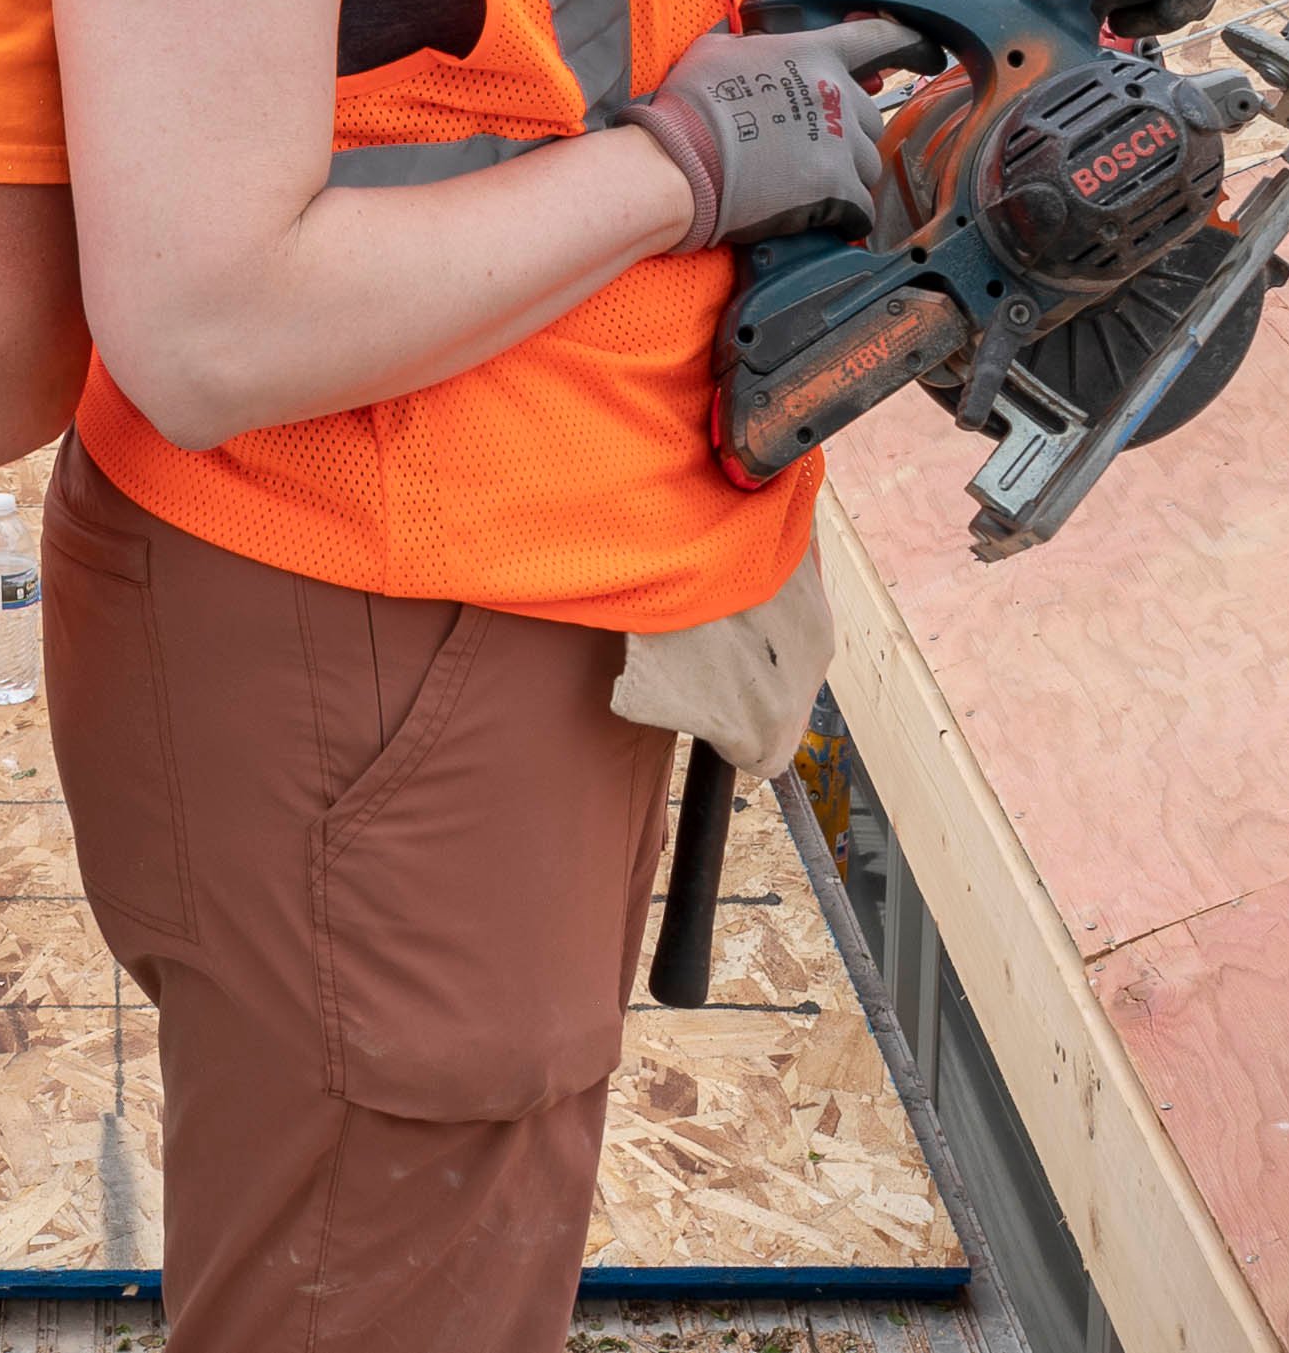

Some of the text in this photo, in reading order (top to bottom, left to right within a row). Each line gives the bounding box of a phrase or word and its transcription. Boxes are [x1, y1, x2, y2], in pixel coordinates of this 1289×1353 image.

[772, 113, 786, 124] 8
[780, 76, 801, 121] Gloves
[784, 59, 820, 142] Comfort Grip
[817, 79, 844, 139] 3M
[1071, 116, 1177, 197] BOSCH
